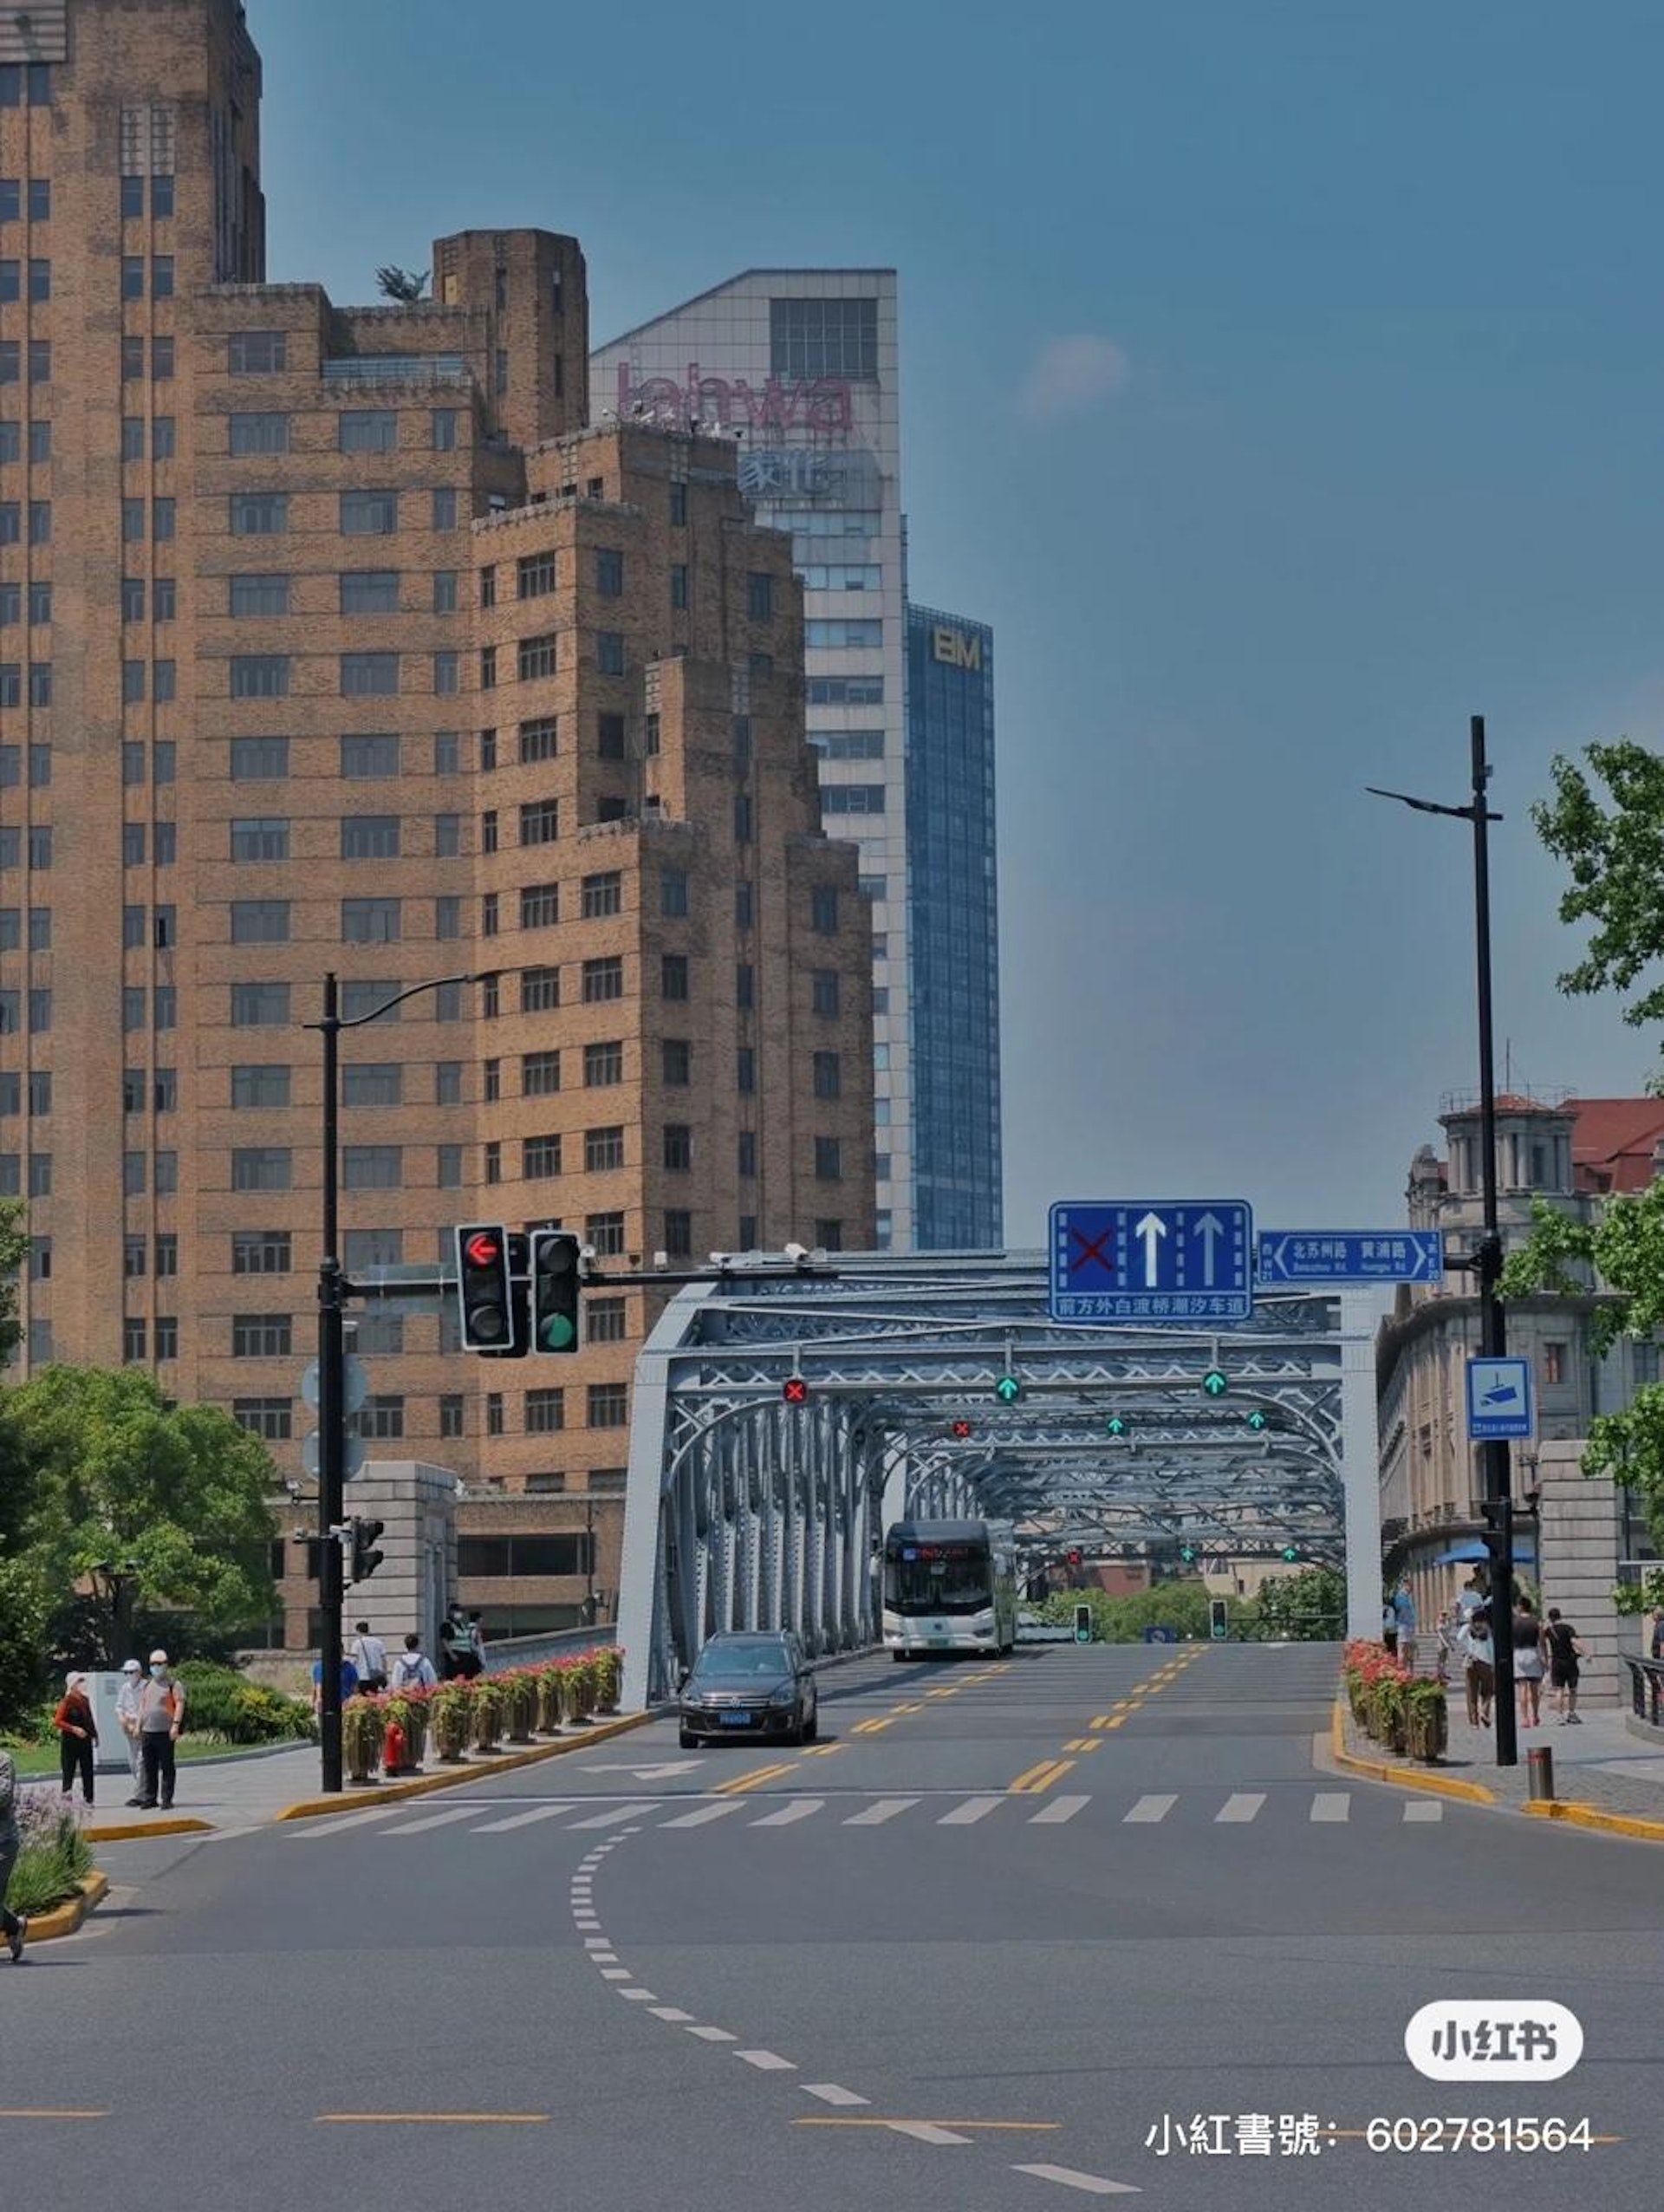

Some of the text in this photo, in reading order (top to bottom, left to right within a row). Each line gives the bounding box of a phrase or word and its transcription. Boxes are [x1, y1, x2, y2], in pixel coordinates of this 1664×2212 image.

[738, 448, 830, 493] 家化
[1293, 1241, 1406, 1259] 北苏州路 黄浦路
[1059, 1298, 1245, 1315] 前方外白渡桥潮汐车道
